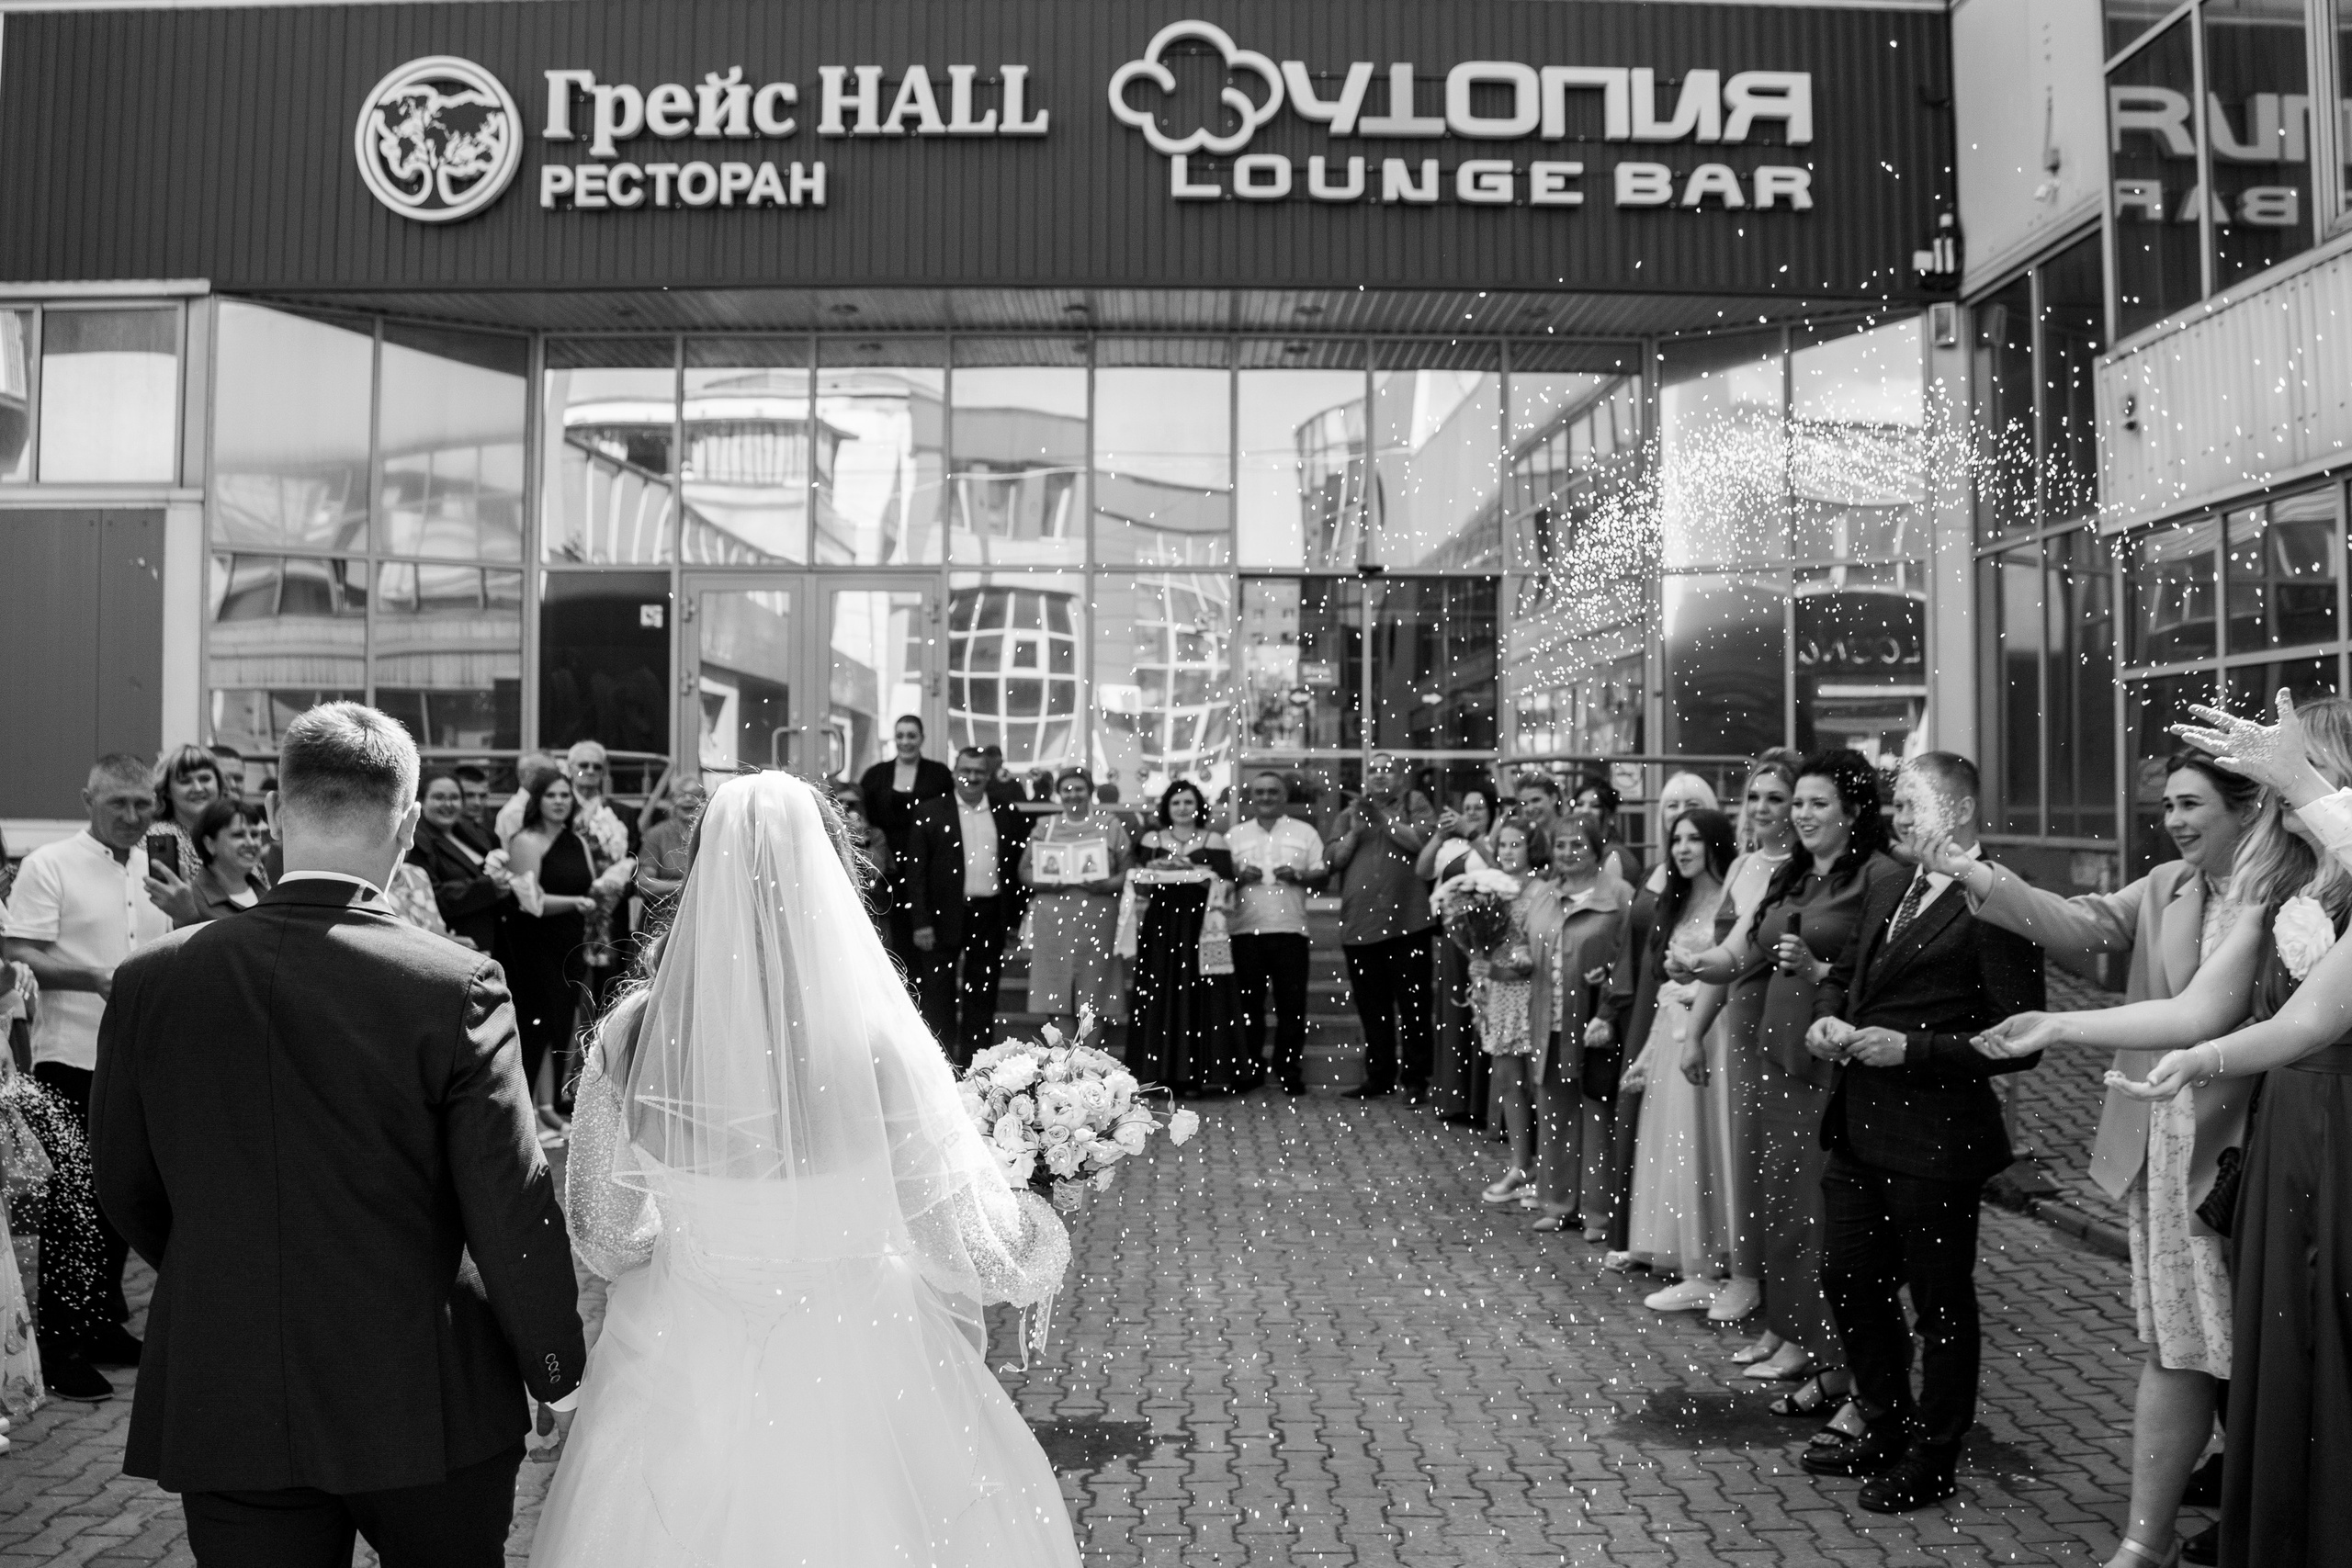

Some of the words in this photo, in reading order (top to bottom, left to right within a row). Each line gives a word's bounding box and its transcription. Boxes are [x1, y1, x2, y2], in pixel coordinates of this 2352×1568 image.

[542, 65, 798, 156] Грейс
[817, 64, 1050, 135] HALL
[540, 161, 827, 209] РЕСТОРАН
[1170, 153, 1585, 205] LOUNGE
[1613, 161, 1815, 210] BAR
